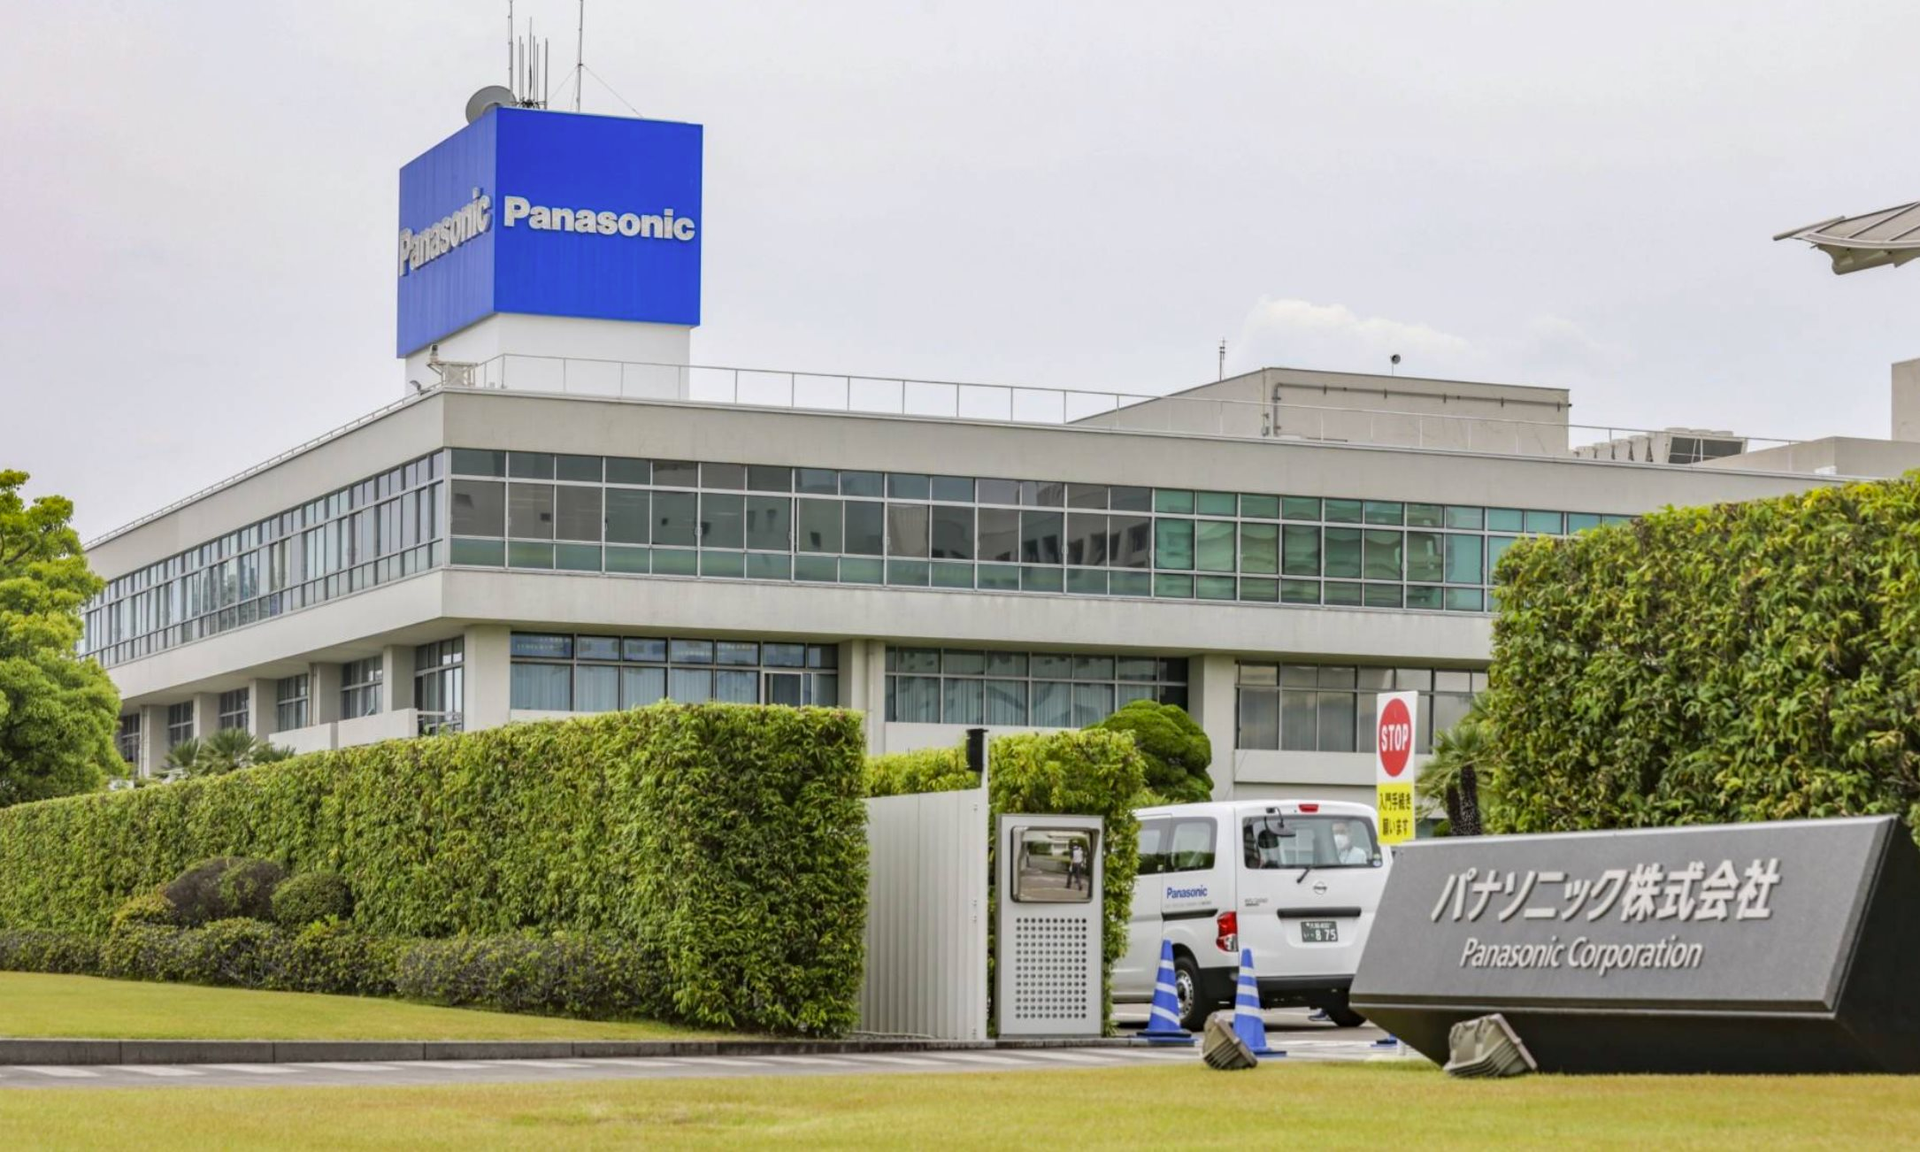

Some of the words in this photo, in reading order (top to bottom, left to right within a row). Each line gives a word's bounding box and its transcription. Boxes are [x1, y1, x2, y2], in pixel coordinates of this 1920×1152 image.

[398, 186, 492, 277] Panasonic
[503, 195, 696, 241] Panasonic
[1381, 723, 1409, 752] STOP
[1166, 885, 1208, 899] Panasonic
[1430, 857, 1783, 922] パナソニック株式会社
[1459, 935, 1565, 969] Panasonic
[1567, 934, 1703, 976] Corporation
